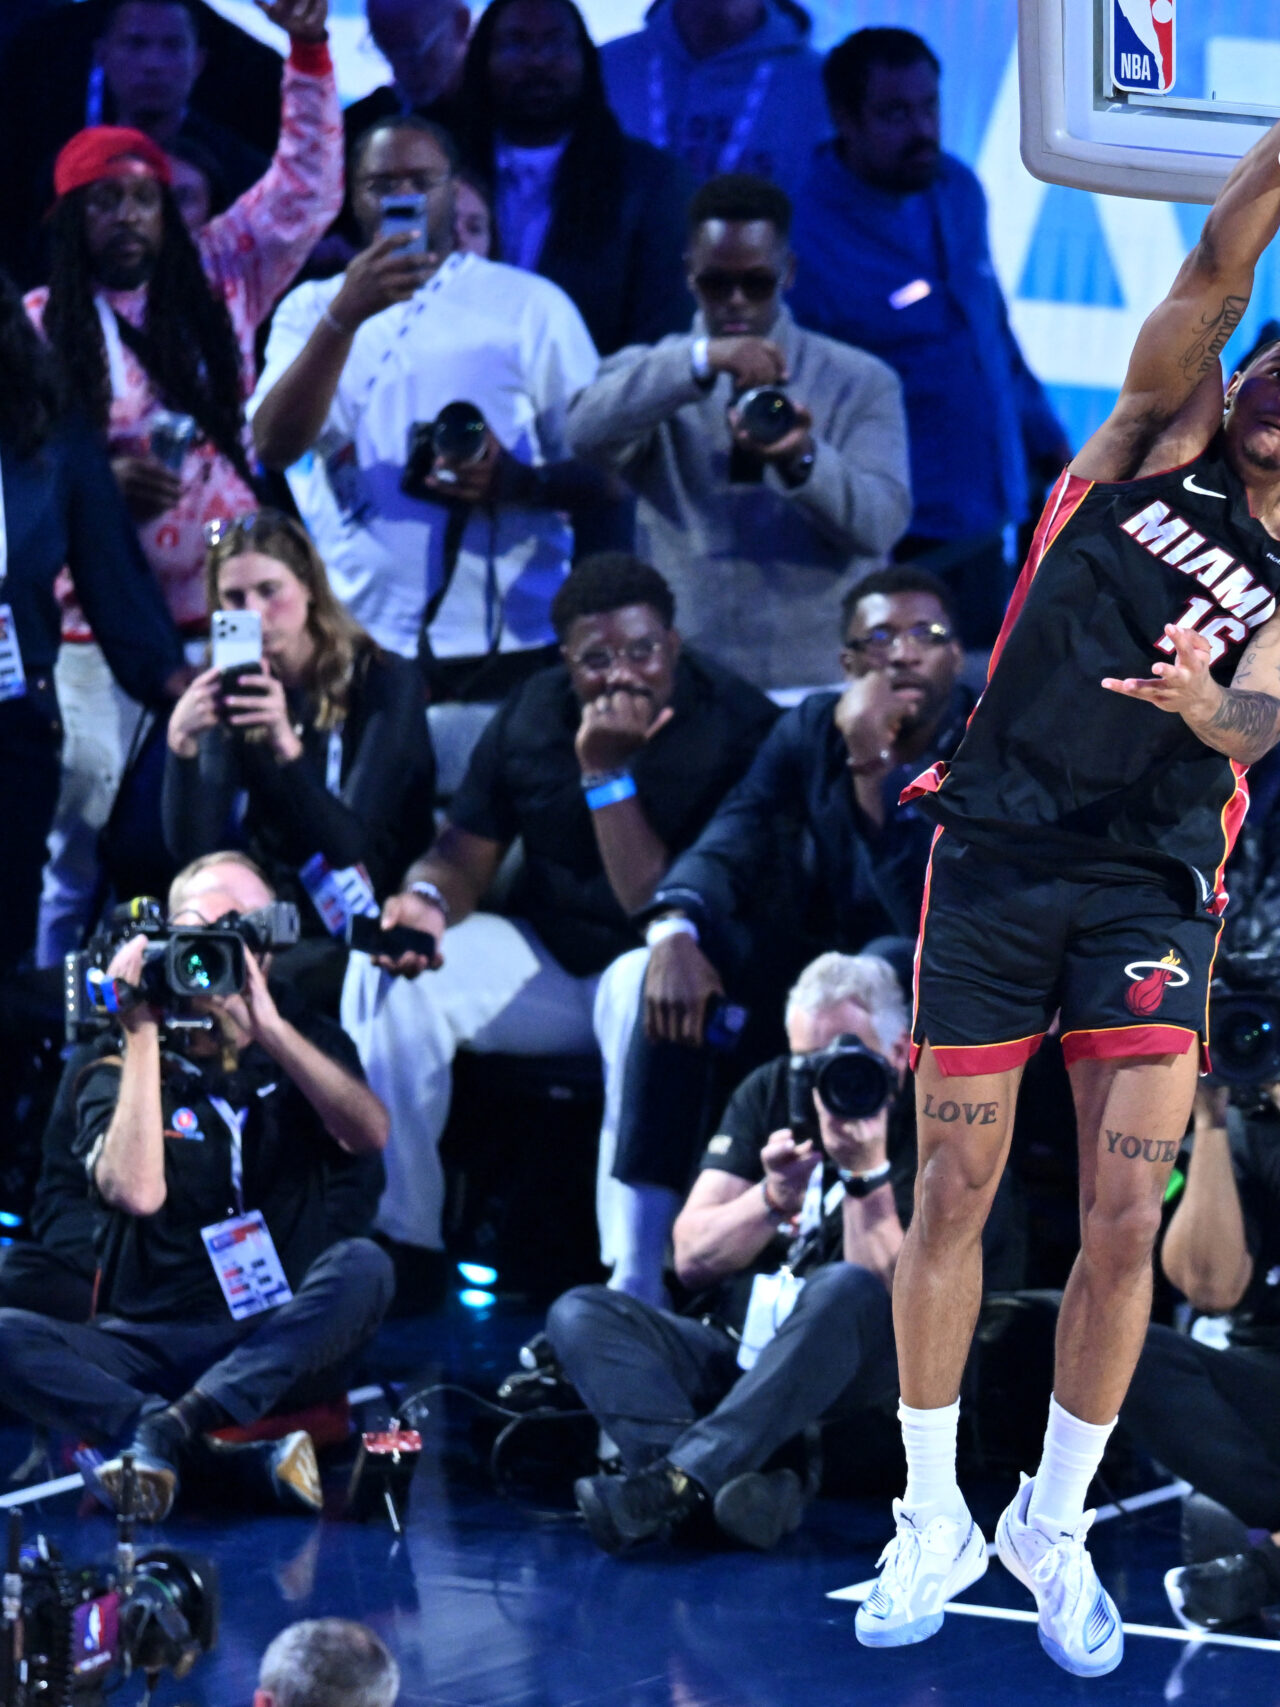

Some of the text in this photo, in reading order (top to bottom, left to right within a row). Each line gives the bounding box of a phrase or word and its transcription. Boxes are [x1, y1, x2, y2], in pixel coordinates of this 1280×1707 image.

[1121, 52, 1151, 81] NBA
[1120, 500, 1276, 629] MIAMI
[1154, 596, 1250, 667] 16
[923, 1094, 999, 1125] LOVE
